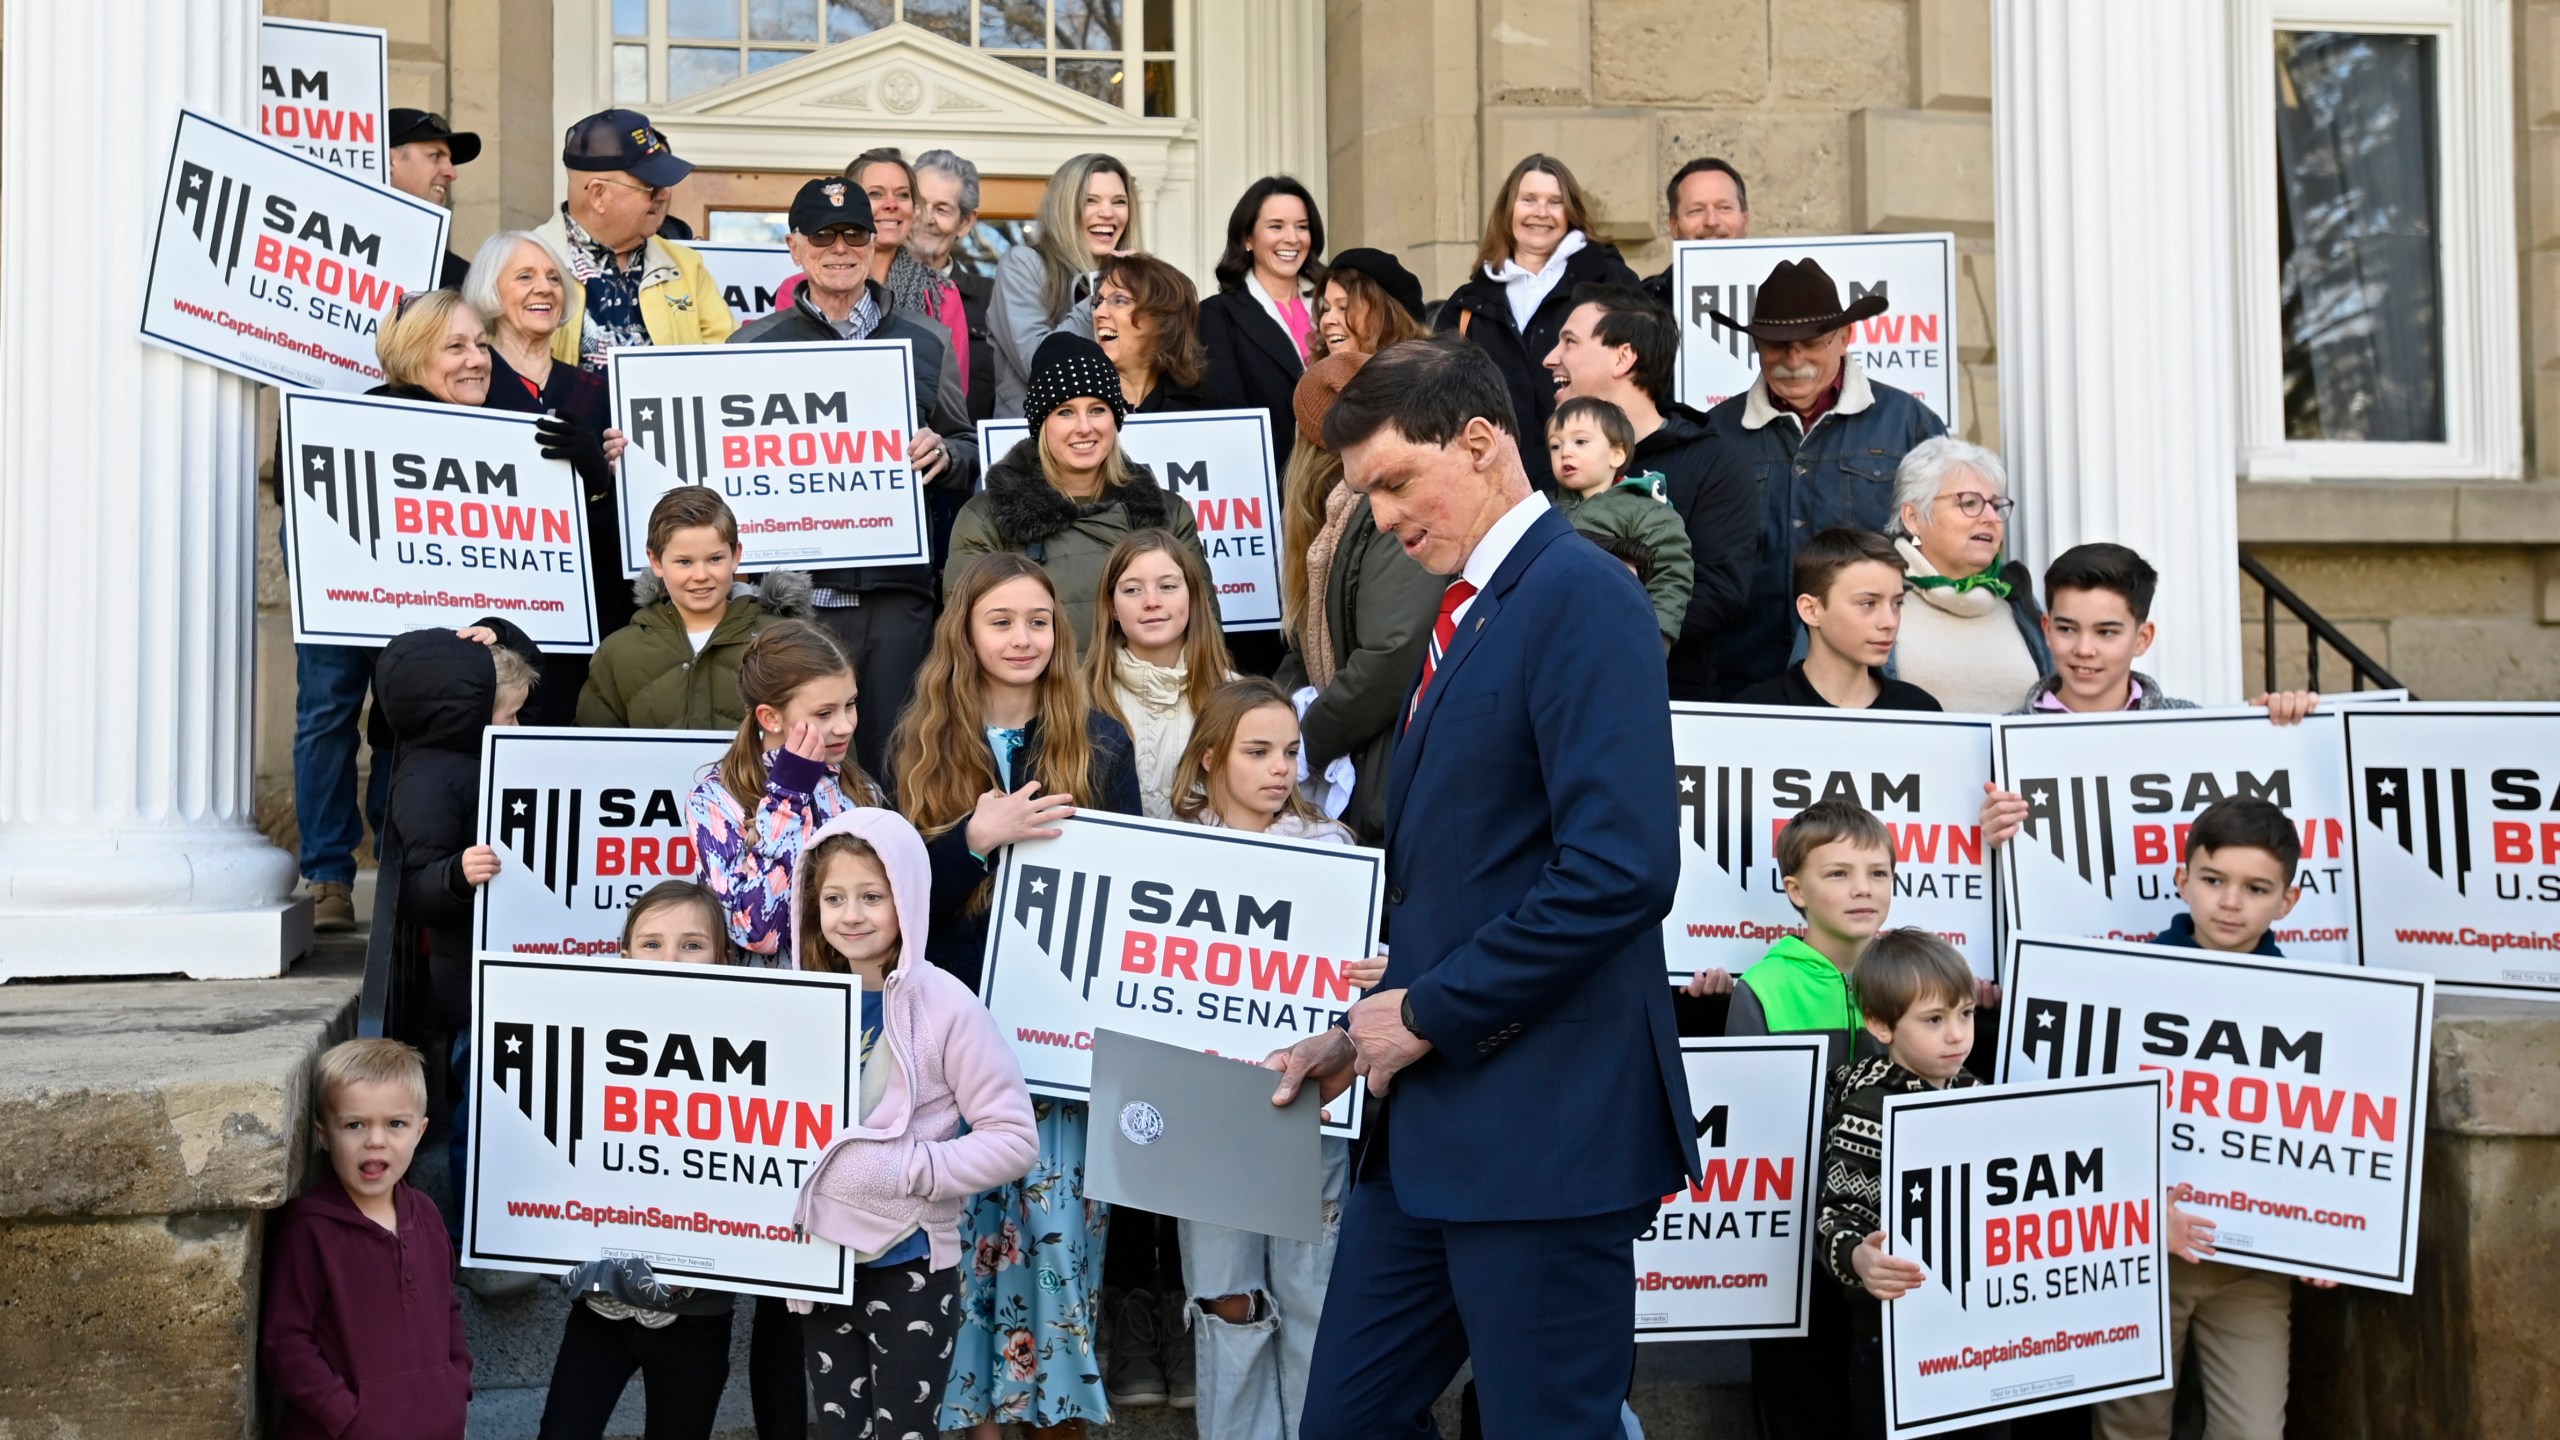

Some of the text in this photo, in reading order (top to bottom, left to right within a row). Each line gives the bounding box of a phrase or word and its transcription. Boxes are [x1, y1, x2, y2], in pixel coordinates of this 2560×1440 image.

[262, 65, 328, 101] AM
[262, 104, 374, 143] OWN
[293, 145, 375, 170] NATE
[262, 194, 381, 268] SAM
[249, 274, 378, 337] U.S. SENA
[723, 285, 779, 313] AM
[1850, 349, 1938, 369] NATE
[720, 391, 848, 428] SAM
[722, 429, 903, 469] BROWN
[392, 453, 518, 497] SAM
[725, 469, 905, 497] U.S. SENATE
[394, 497, 571, 544] BROWN
[737, 516, 893, 534] ainSamBrown.com
[397, 541, 574, 573] U.S. SENATE
[1202, 535, 1266, 559] ATE
[326, 587, 564, 612] www.CaptainSamBrown.com
[599, 788, 682, 828] SA
[1772, 768, 1921, 813] SAM
[2129, 769, 2292, 814] SAM
[595, 836, 697, 876] BRO
[594, 884, 643, 910] U.S
[1892, 872, 1983, 900] NATE
[2496, 873, 2560, 902] U.S
[1128, 880, 1292, 941] SAM
[1120, 929, 1352, 1003] BROWN
[1115, 980, 1184, 1016] U.S.
[605, 1028, 767, 1086] SAM
[2142, 1011, 2323, 1075] SAM
[603, 1085, 833, 1151] BROWN
[602, 1141, 817, 1189] U.S. SENAT
[2171, 1122, 2393, 1182] S. SENATE
[1986, 1147, 2104, 1207] SAM
[2167, 1183, 2367, 1230] SamBrown.com
[1985, 1197, 2150, 1268] BROWN
[604, 1249, 619, 1257] Paid
[677, 1256, 688, 1264] for
[688, 1257, 713, 1268] Nevada
[1986, 1255, 2151, 1308] U.S. SENATE
[1918, 1323, 2140, 1377] www.CaptainSamBrown.com
